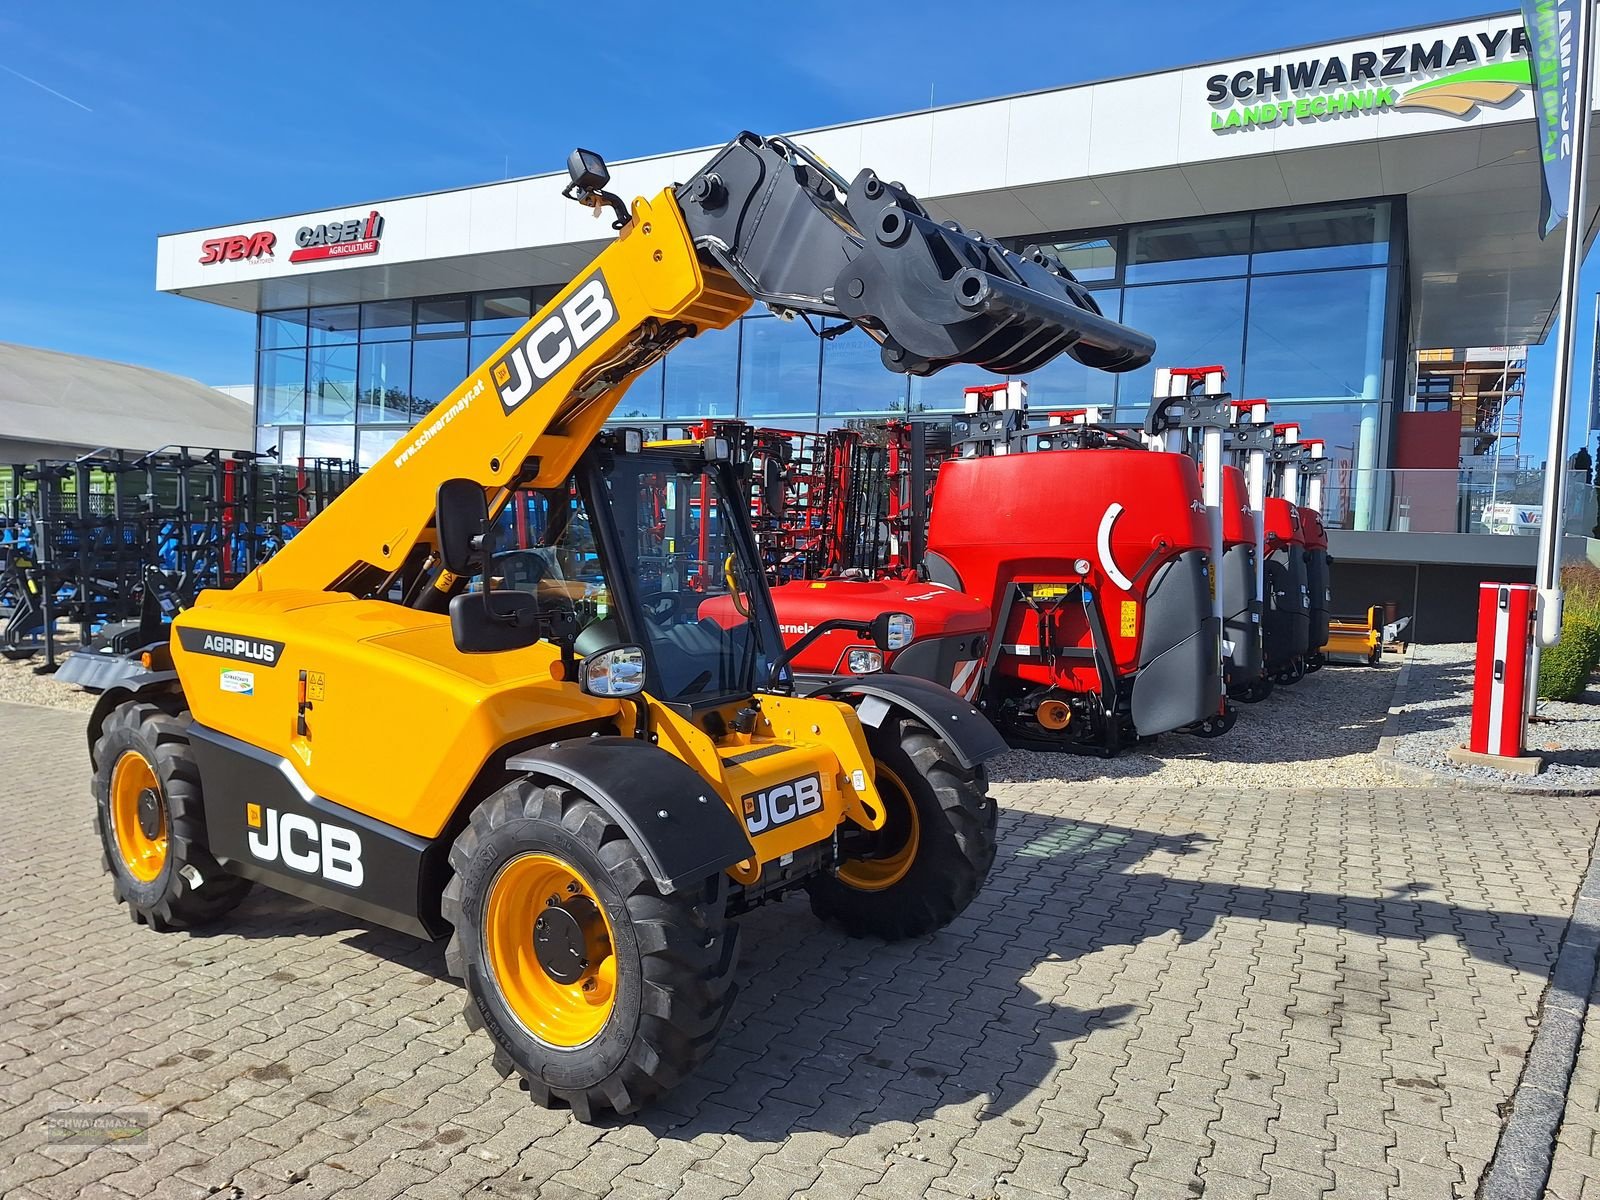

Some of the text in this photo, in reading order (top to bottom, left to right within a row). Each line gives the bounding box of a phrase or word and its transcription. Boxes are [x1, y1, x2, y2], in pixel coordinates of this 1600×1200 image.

[1206, 27, 1531, 102] SCHWARZMAYR
[1211, 86, 1393, 131] LANDTECHNIK
[199, 231, 276, 265] STEYR
[295, 219, 358, 249] CASE
[329, 241, 373, 256] AGRICULTURE
[501, 279, 614, 407] JCB
[394, 378, 485, 468] www.schwarzmayr.at
[746, 776, 821, 833] JCB
[248, 808, 364, 888] JCB
